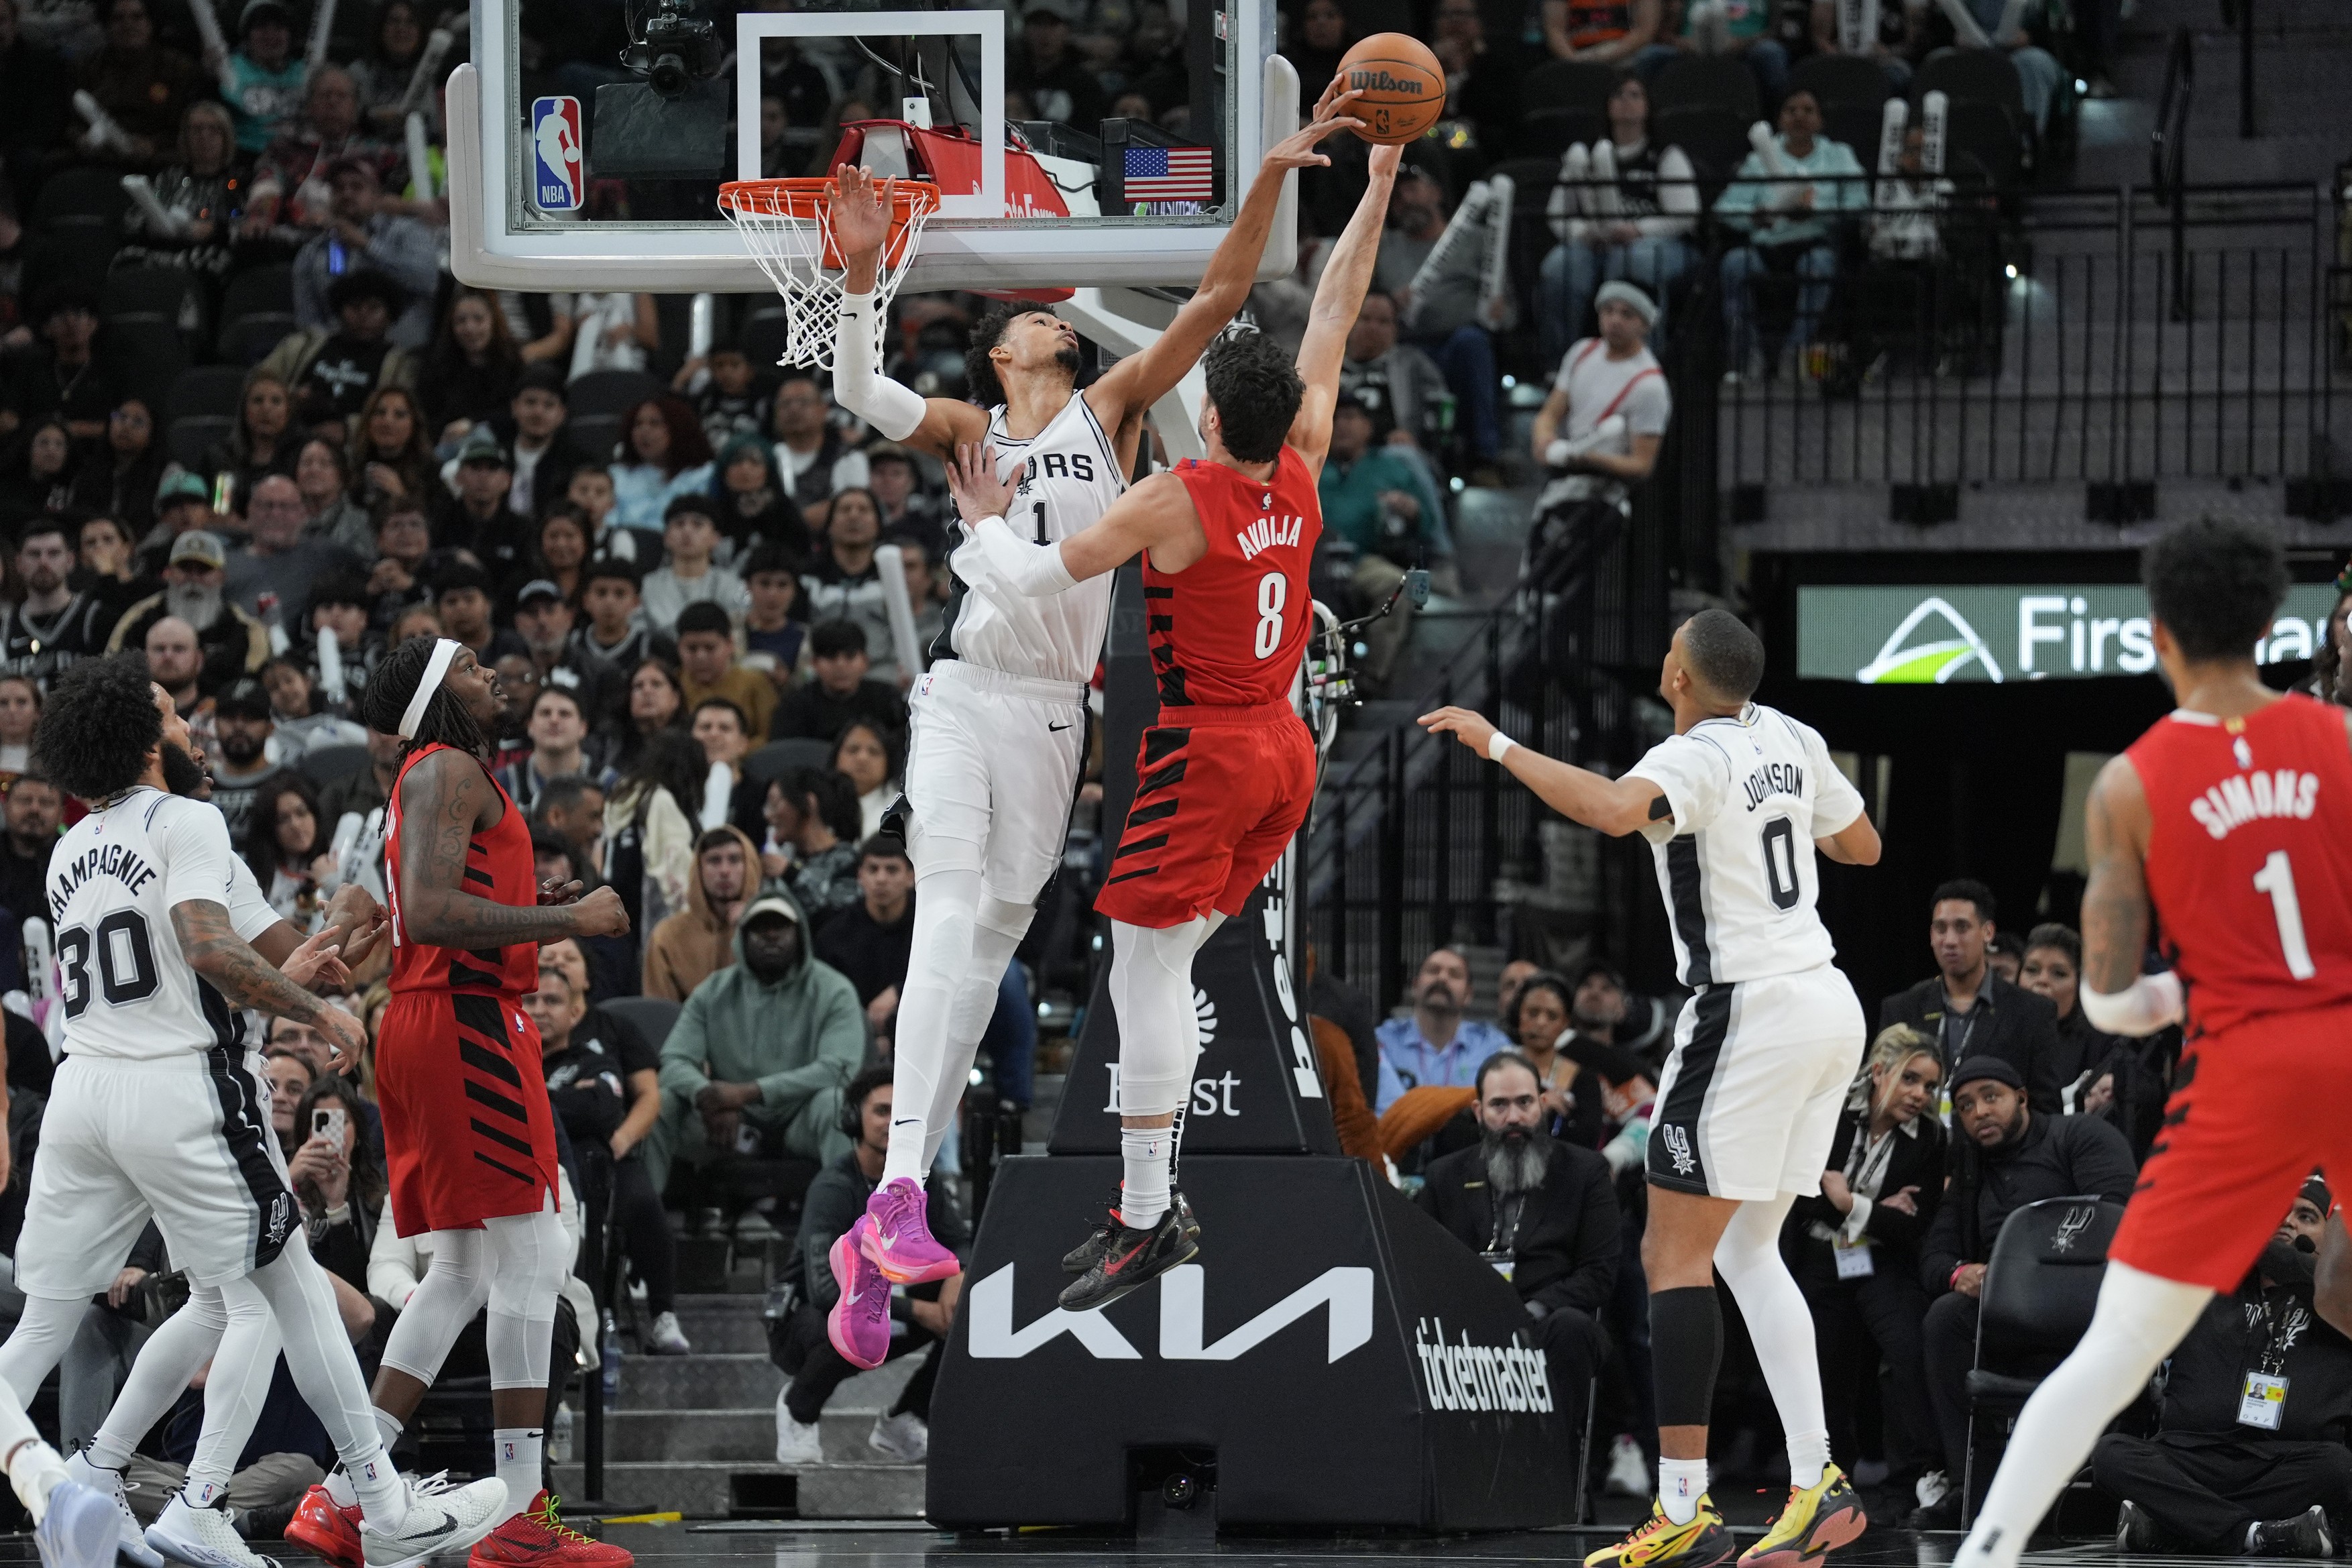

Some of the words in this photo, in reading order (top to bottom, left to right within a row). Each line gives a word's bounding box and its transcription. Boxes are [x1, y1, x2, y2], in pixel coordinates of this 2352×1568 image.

[1350, 70, 1423, 95] Wilson
[542, 185, 565, 203] NBA
[1031, 500, 1054, 547] 1
[1237, 514, 1303, 561] AVDIJA
[1253, 571, 1288, 660] 8
[1742, 763, 1803, 813] JOHNSON
[2190, 768, 2320, 841] SIMONS
[1759, 814, 1802, 913] 0
[2253, 849, 2317, 981] 1
[56, 905, 163, 1023] 30
[968, 1261, 1374, 1364] KIA
[1416, 1316, 1555, 1413] ticketmaster
